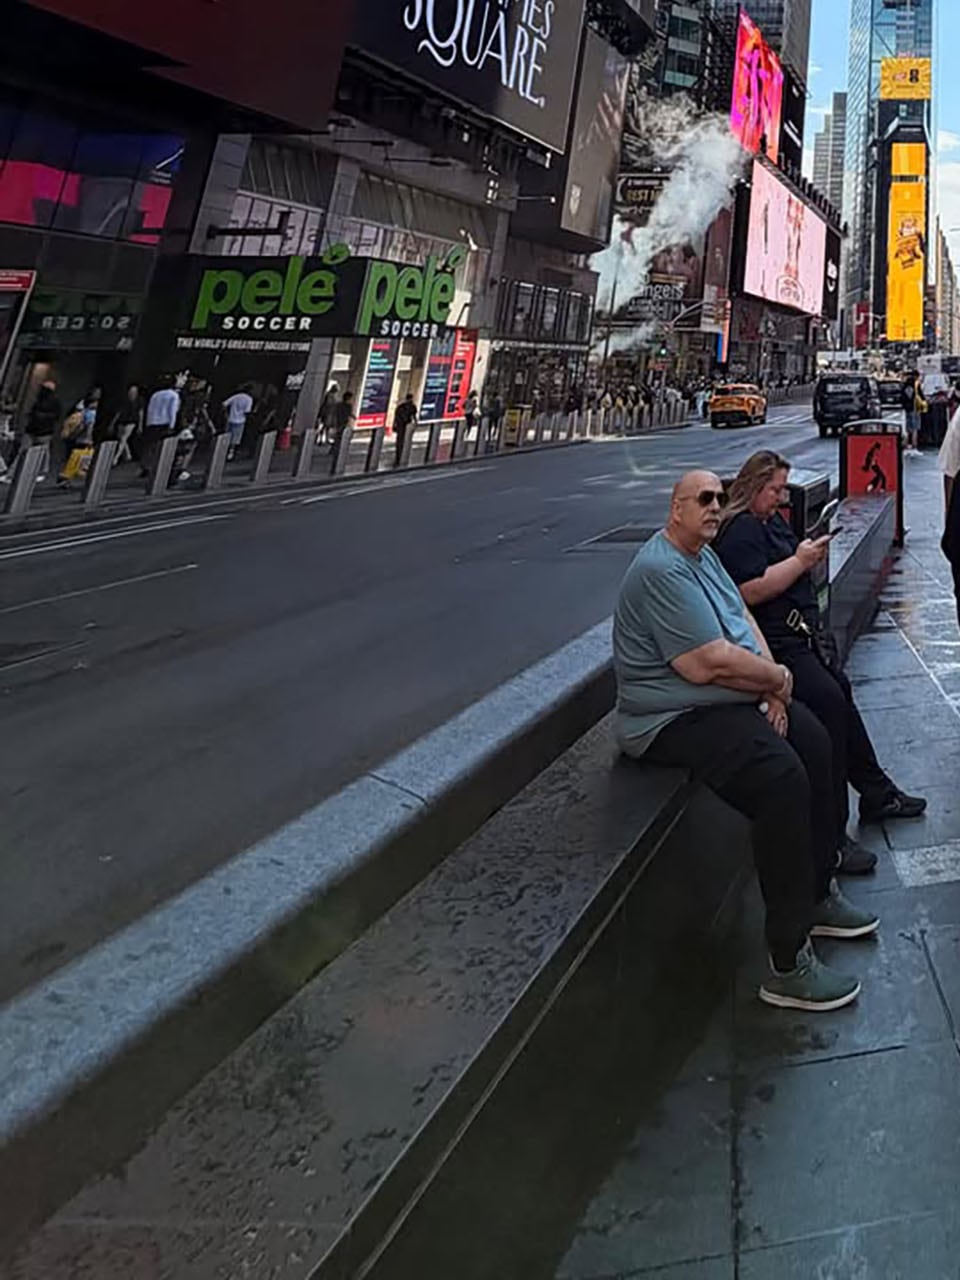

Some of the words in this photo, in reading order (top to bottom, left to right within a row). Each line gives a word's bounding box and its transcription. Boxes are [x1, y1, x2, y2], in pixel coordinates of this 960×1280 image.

[222, 316, 312, 331] SOCCER
[381, 319, 439, 338] SOCCER
[176, 337, 193, 348] THE
[194, 338, 226, 349] WORLD'S
